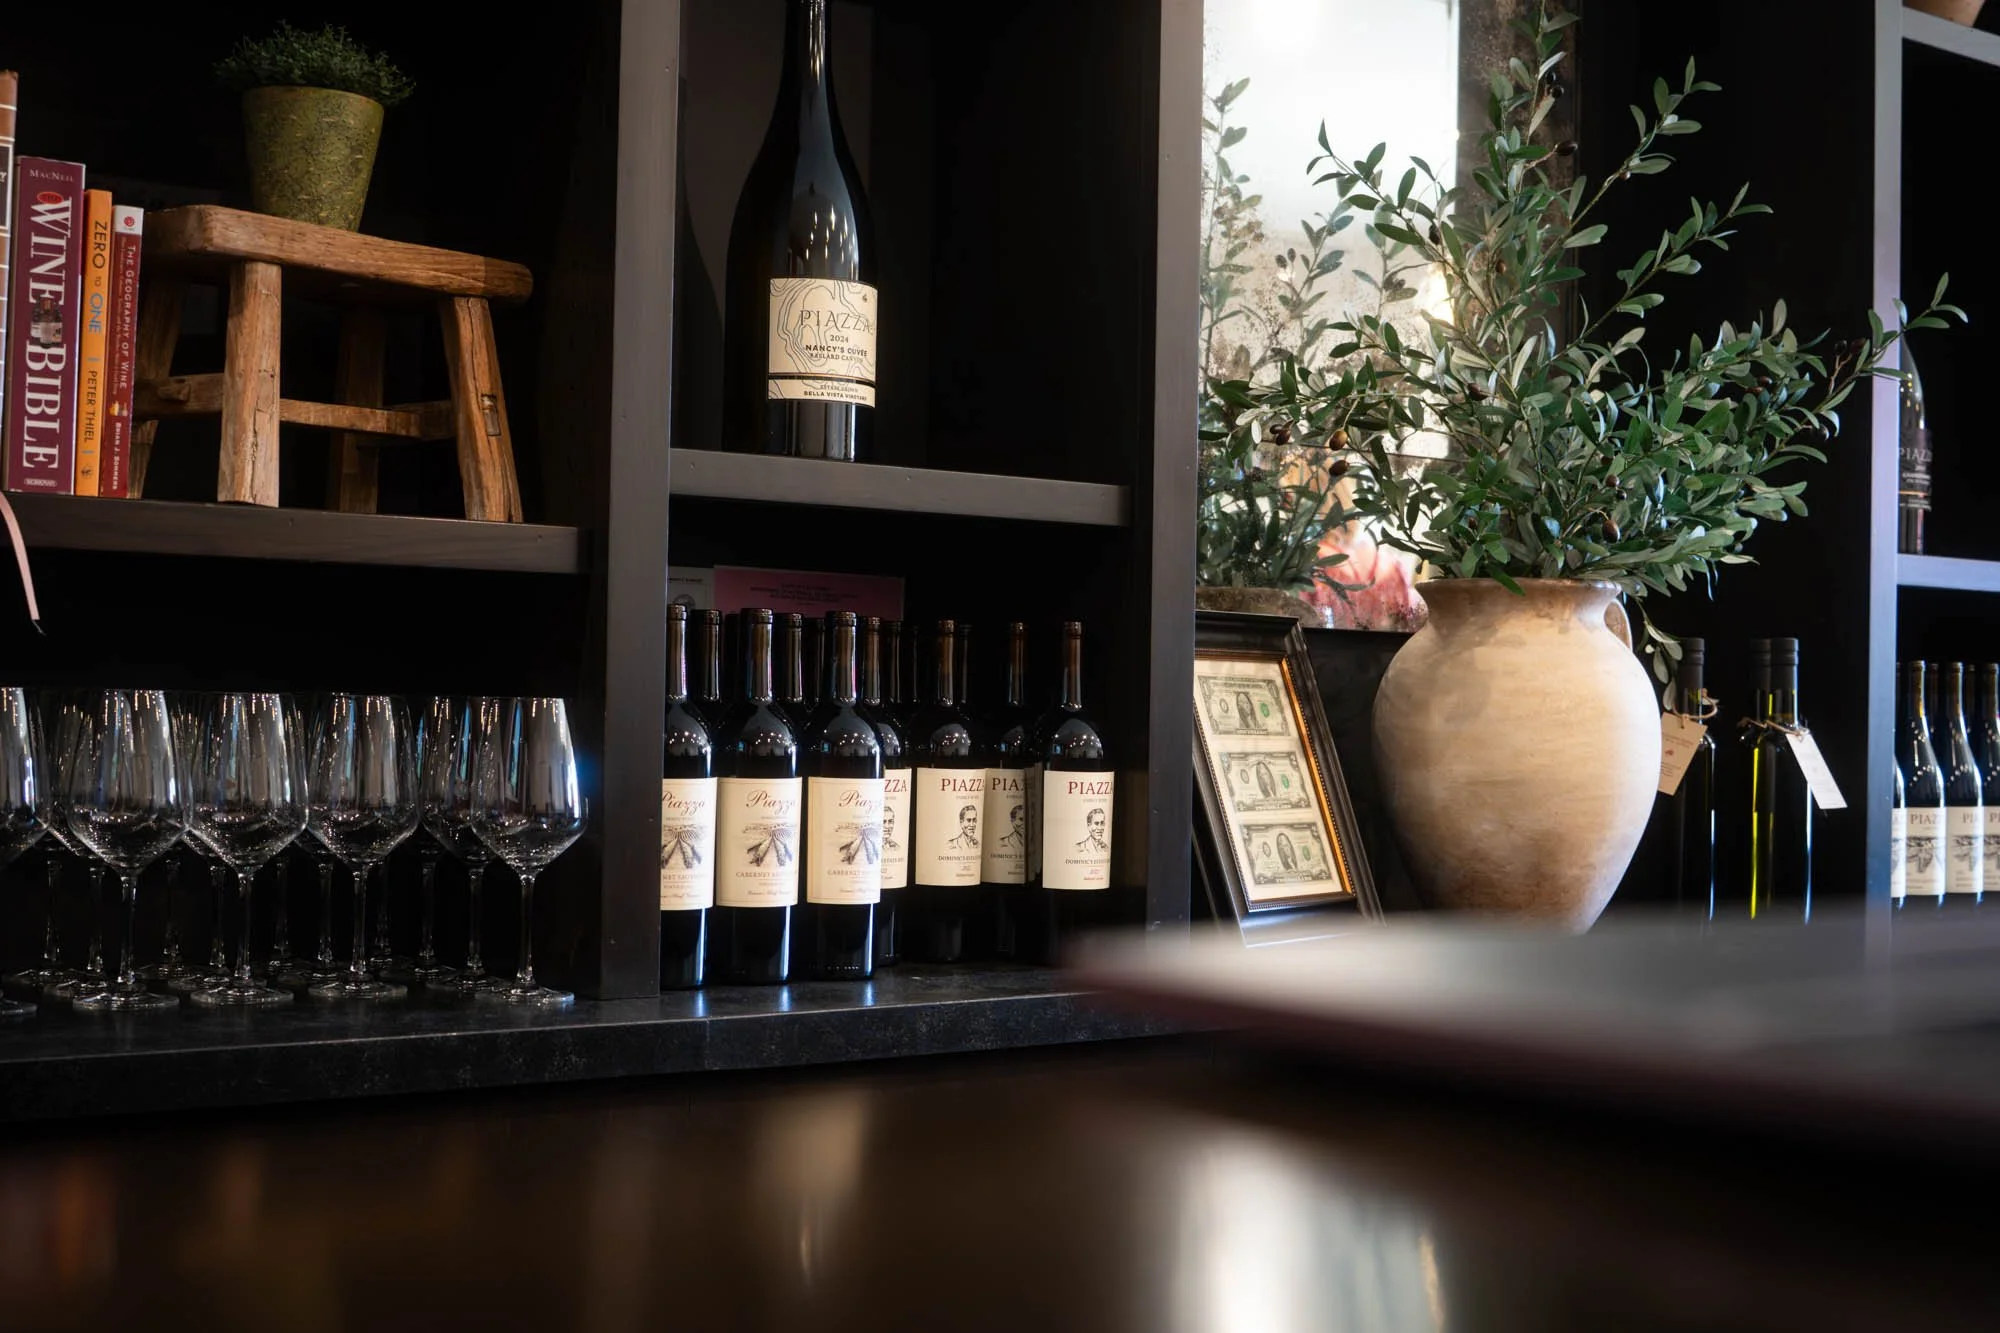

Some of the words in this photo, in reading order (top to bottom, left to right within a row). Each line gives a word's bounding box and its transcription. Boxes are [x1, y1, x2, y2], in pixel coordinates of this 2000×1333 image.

[29, 197, 72, 305] WINE
[92, 220, 107, 270] ZERO
[126, 244, 137, 265] THE
[88, 292, 104, 335] ONE
[122, 270, 135, 338] GEOGRAPHY
[800, 310, 872, 334] PIAZZA
[121, 342, 129, 357] OF
[805, 344, 845, 353] NANCY'S
[86, 370, 98, 406] PETER
[119, 361, 130, 389] WINE
[23, 340, 66, 469] BIBLE
[84, 409, 96, 443] THIEL
[114, 422, 122, 446] BRIAN
[884, 779, 907, 793] ZZA
[991, 777, 1024, 791] PIA
[662, 790, 705, 816] Piazza
[746, 790, 796, 815] Piazza
